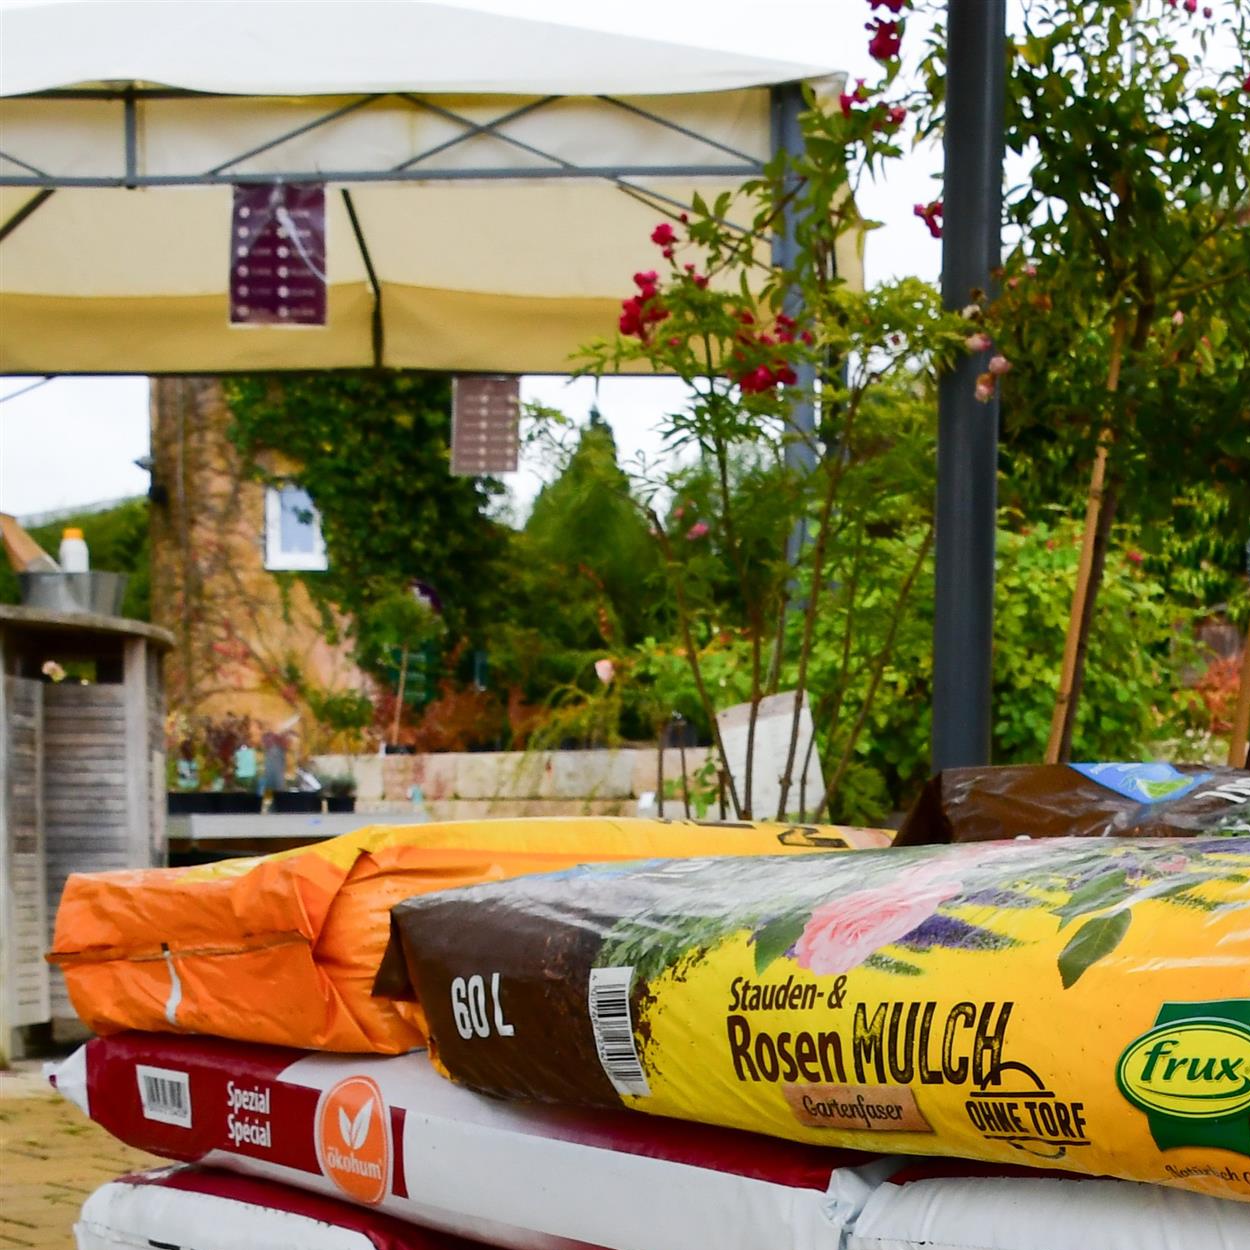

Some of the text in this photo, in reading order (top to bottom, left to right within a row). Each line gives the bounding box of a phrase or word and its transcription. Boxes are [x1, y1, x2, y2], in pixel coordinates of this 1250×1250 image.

[728, 975, 847, 1012] Stauden- &
[727, 1001, 1014, 1086] Rosen MULCH
[1139, 1039, 1247, 1085] frux
[227, 1080, 270, 1115] Spezial
[802, 1095, 905, 1126] Gartenfaser
[227, 1114, 271, 1147] Spécial
[965, 1099, 1087, 1139] OHNE TORF
[327, 1146, 382, 1180] ökohum
